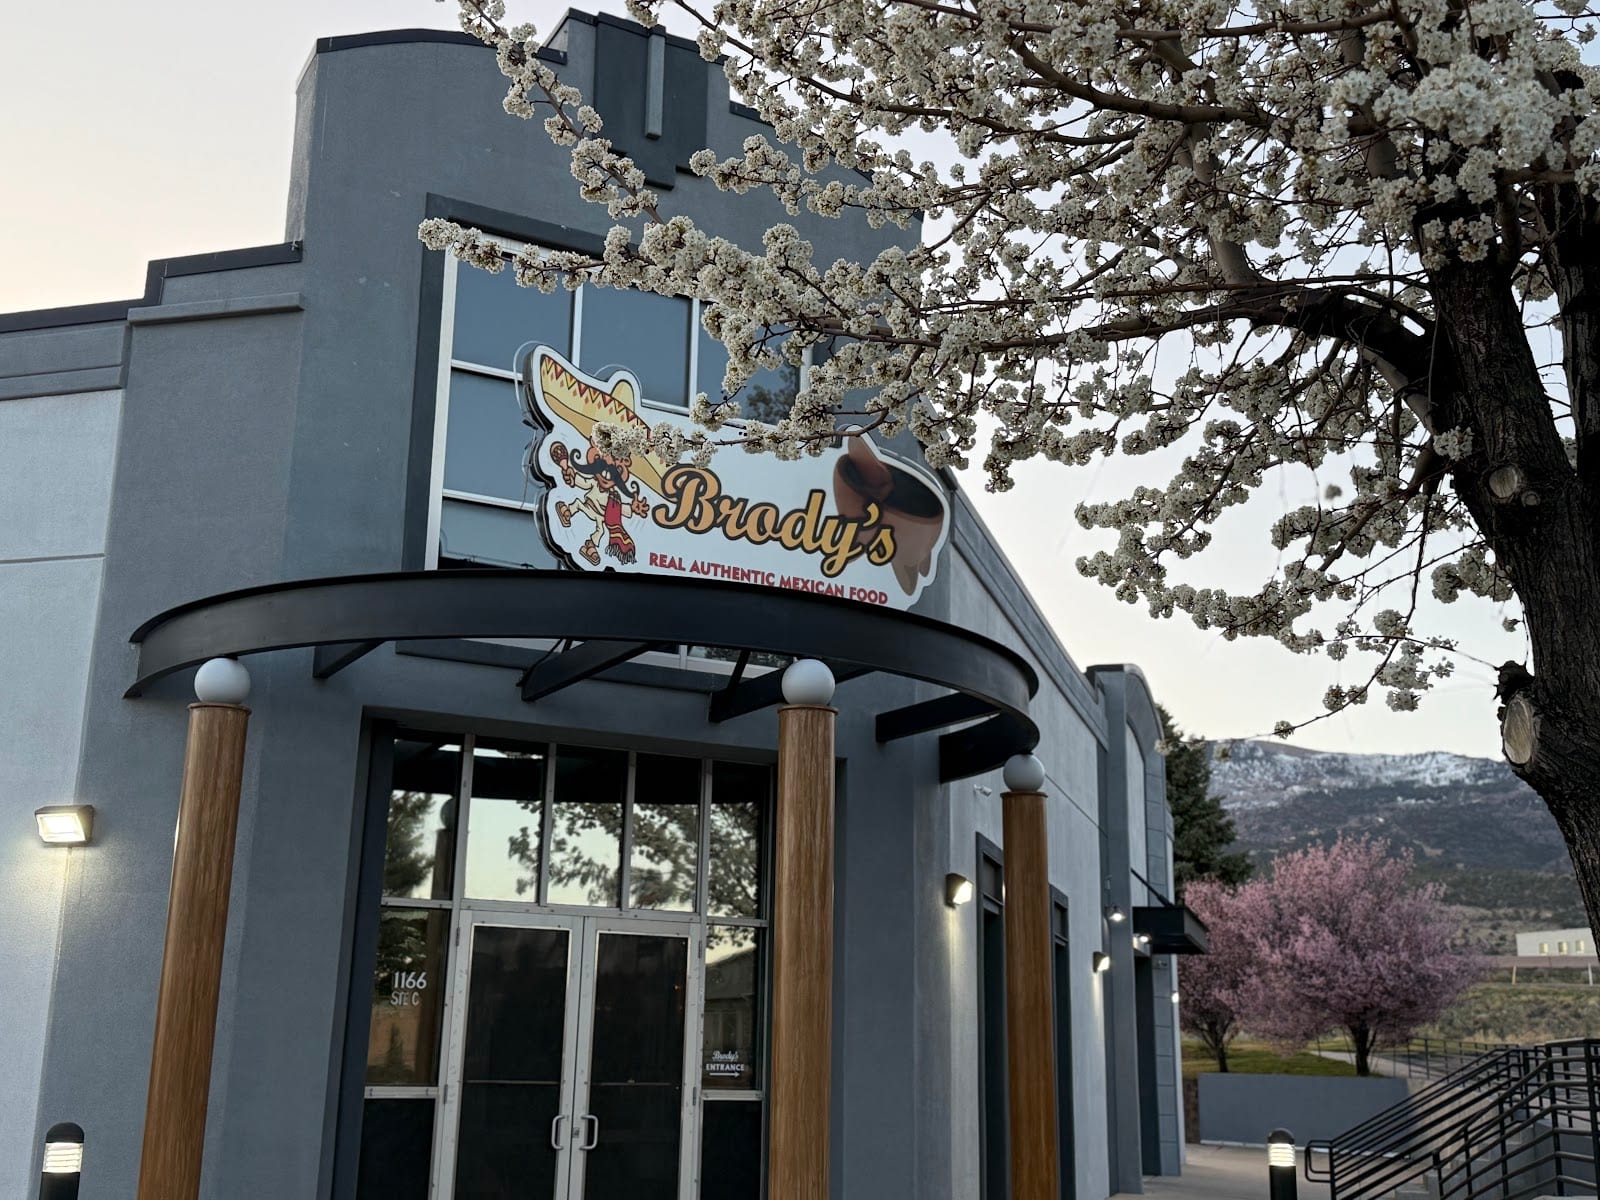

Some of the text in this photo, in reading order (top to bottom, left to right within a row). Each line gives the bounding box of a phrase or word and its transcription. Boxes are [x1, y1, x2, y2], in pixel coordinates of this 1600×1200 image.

[651, 463, 896, 578] Brody's
[649, 552, 888, 604] REAL AUTHENTIC MEXICAN FOOD
[394, 971, 427, 989] 1166
[390, 991, 420, 1006] STE C
[706, 1063, 745, 1071] ENTRANCE
